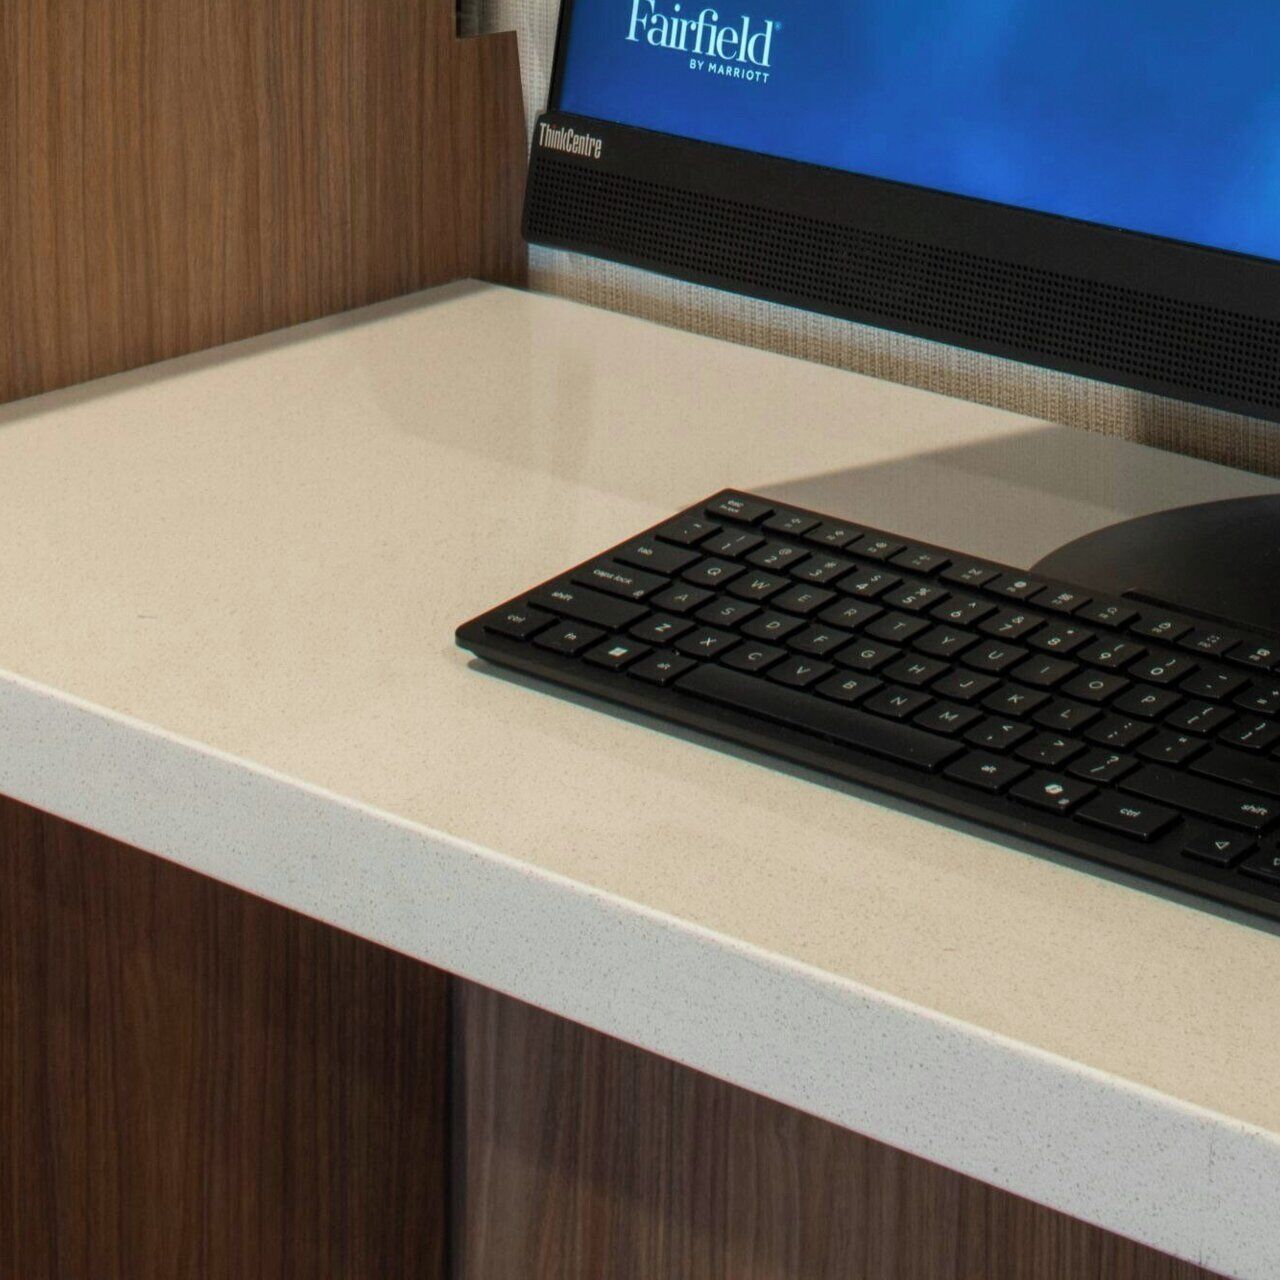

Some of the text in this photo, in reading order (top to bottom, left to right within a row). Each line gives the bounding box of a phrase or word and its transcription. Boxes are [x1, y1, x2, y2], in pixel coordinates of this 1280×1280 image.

[690, 58, 770, 83] BY MARRIOTT
[540, 123, 602, 158] ThinkCentre
[708, 568, 721, 576] Q
[752, 580, 769, 589] W
[798, 594, 811, 602] E
[700, 638, 716, 646] X
[861, 650, 875, 658] G
[988, 651, 1003, 659] U
[797, 666, 810, 674] V
[909, 665, 925, 673] H
[843, 681, 857, 689] B
[891, 697, 907, 705] N
[1008, 695, 1024, 703] K
[940, 712, 958, 721] M
[1061, 710, 1070, 718] L
[1120, 809, 1140, 817] ctrl
[1241, 805, 1267, 815] shift
